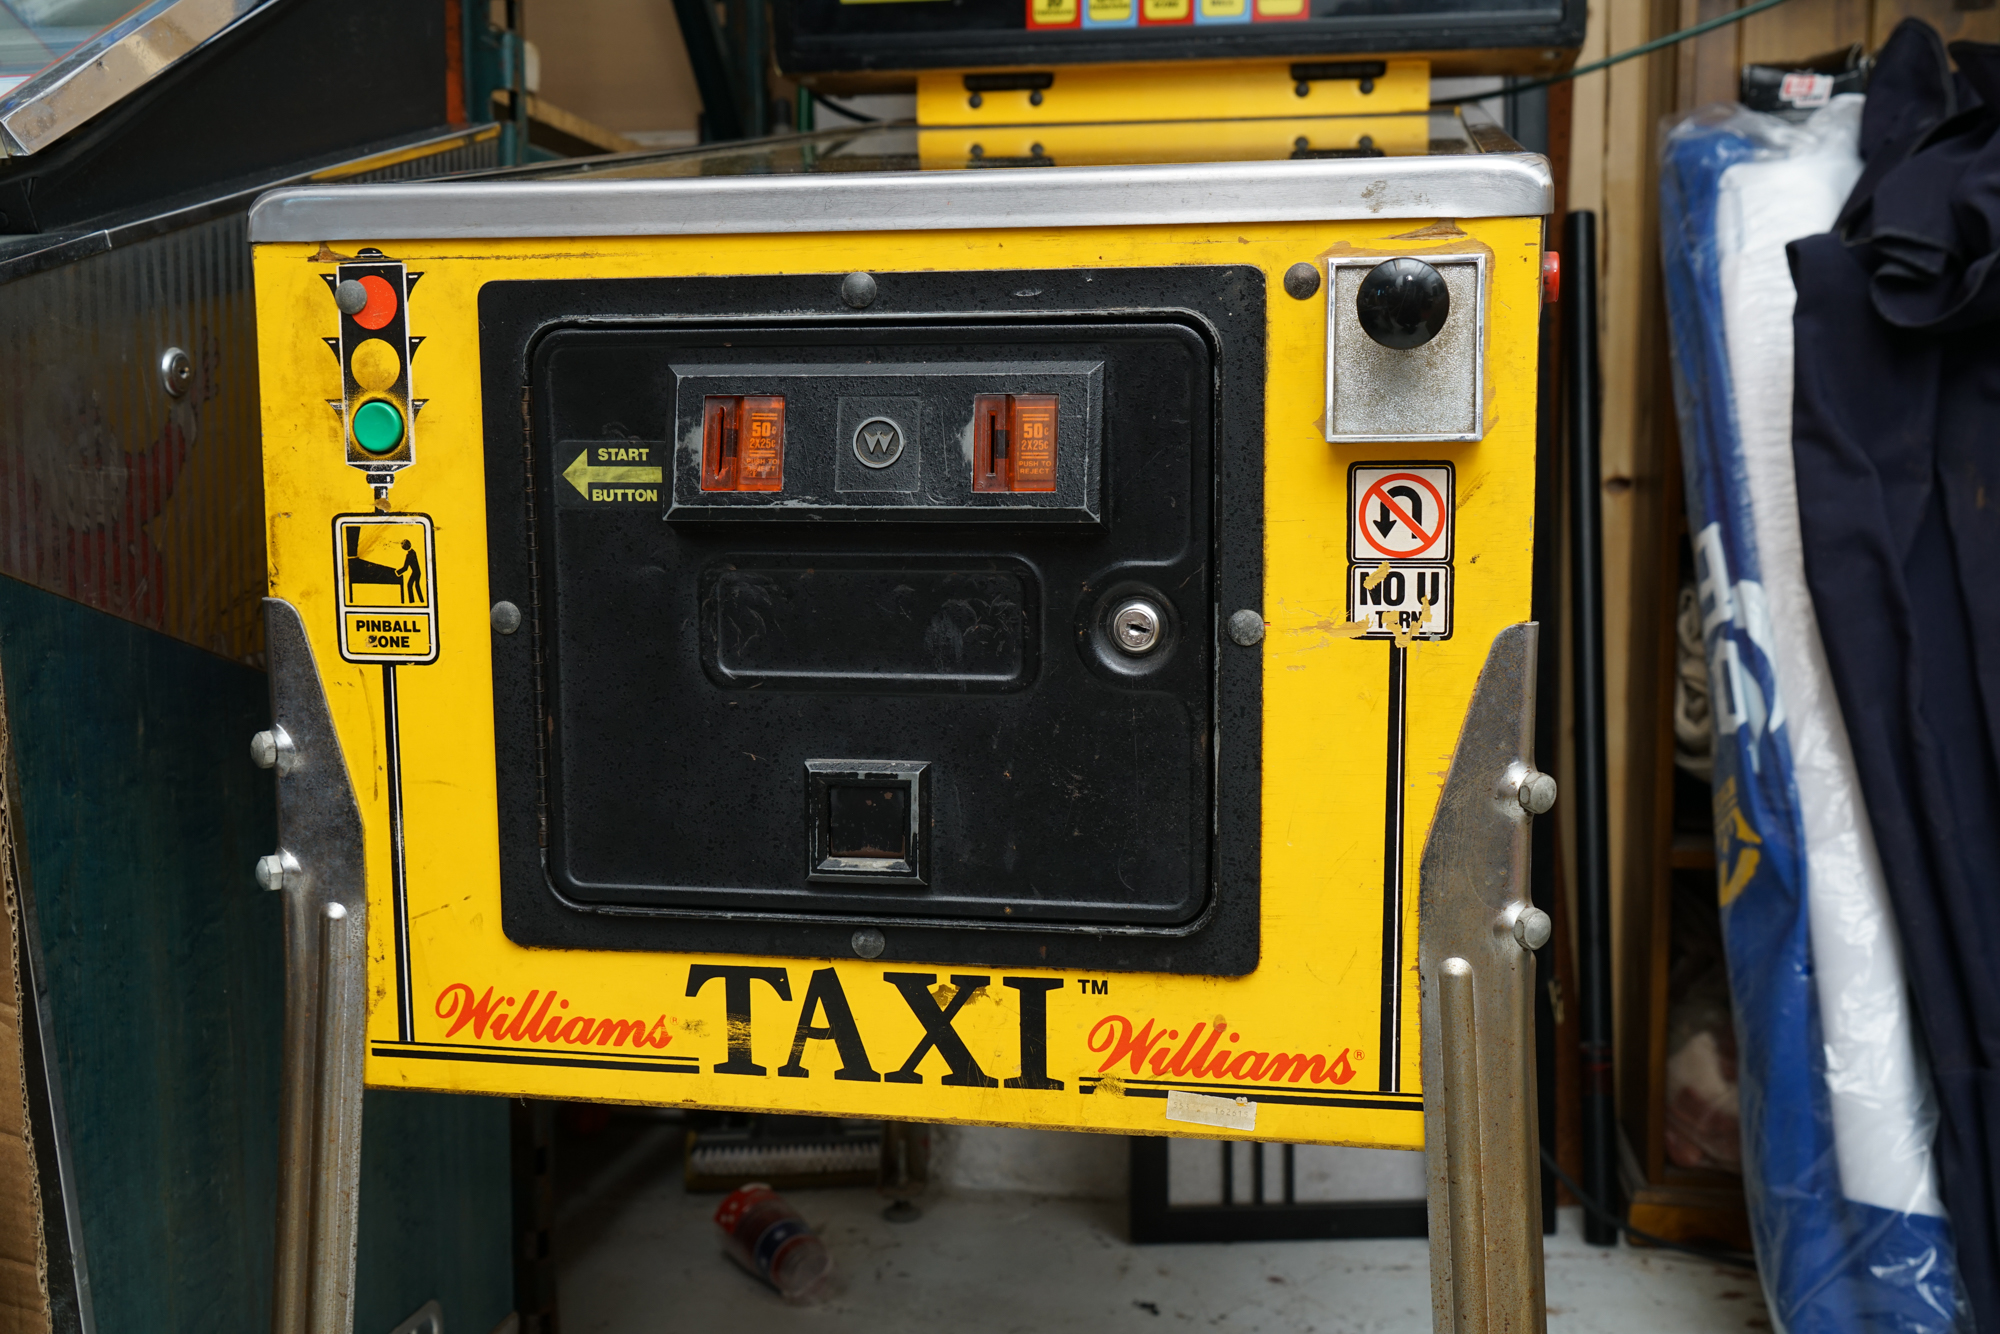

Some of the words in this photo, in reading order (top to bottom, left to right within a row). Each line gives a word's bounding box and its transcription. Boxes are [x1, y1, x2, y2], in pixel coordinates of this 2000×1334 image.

[597, 448, 650, 461] START
[1019, 467, 1050, 475] REJECT
[592, 488, 658, 502] BUTTON
[1359, 571, 1406, 607] NO
[1417, 571, 1440, 607] U
[355, 620, 421, 633] PINBALL
[685, 963, 1065, 1091] TAXI
